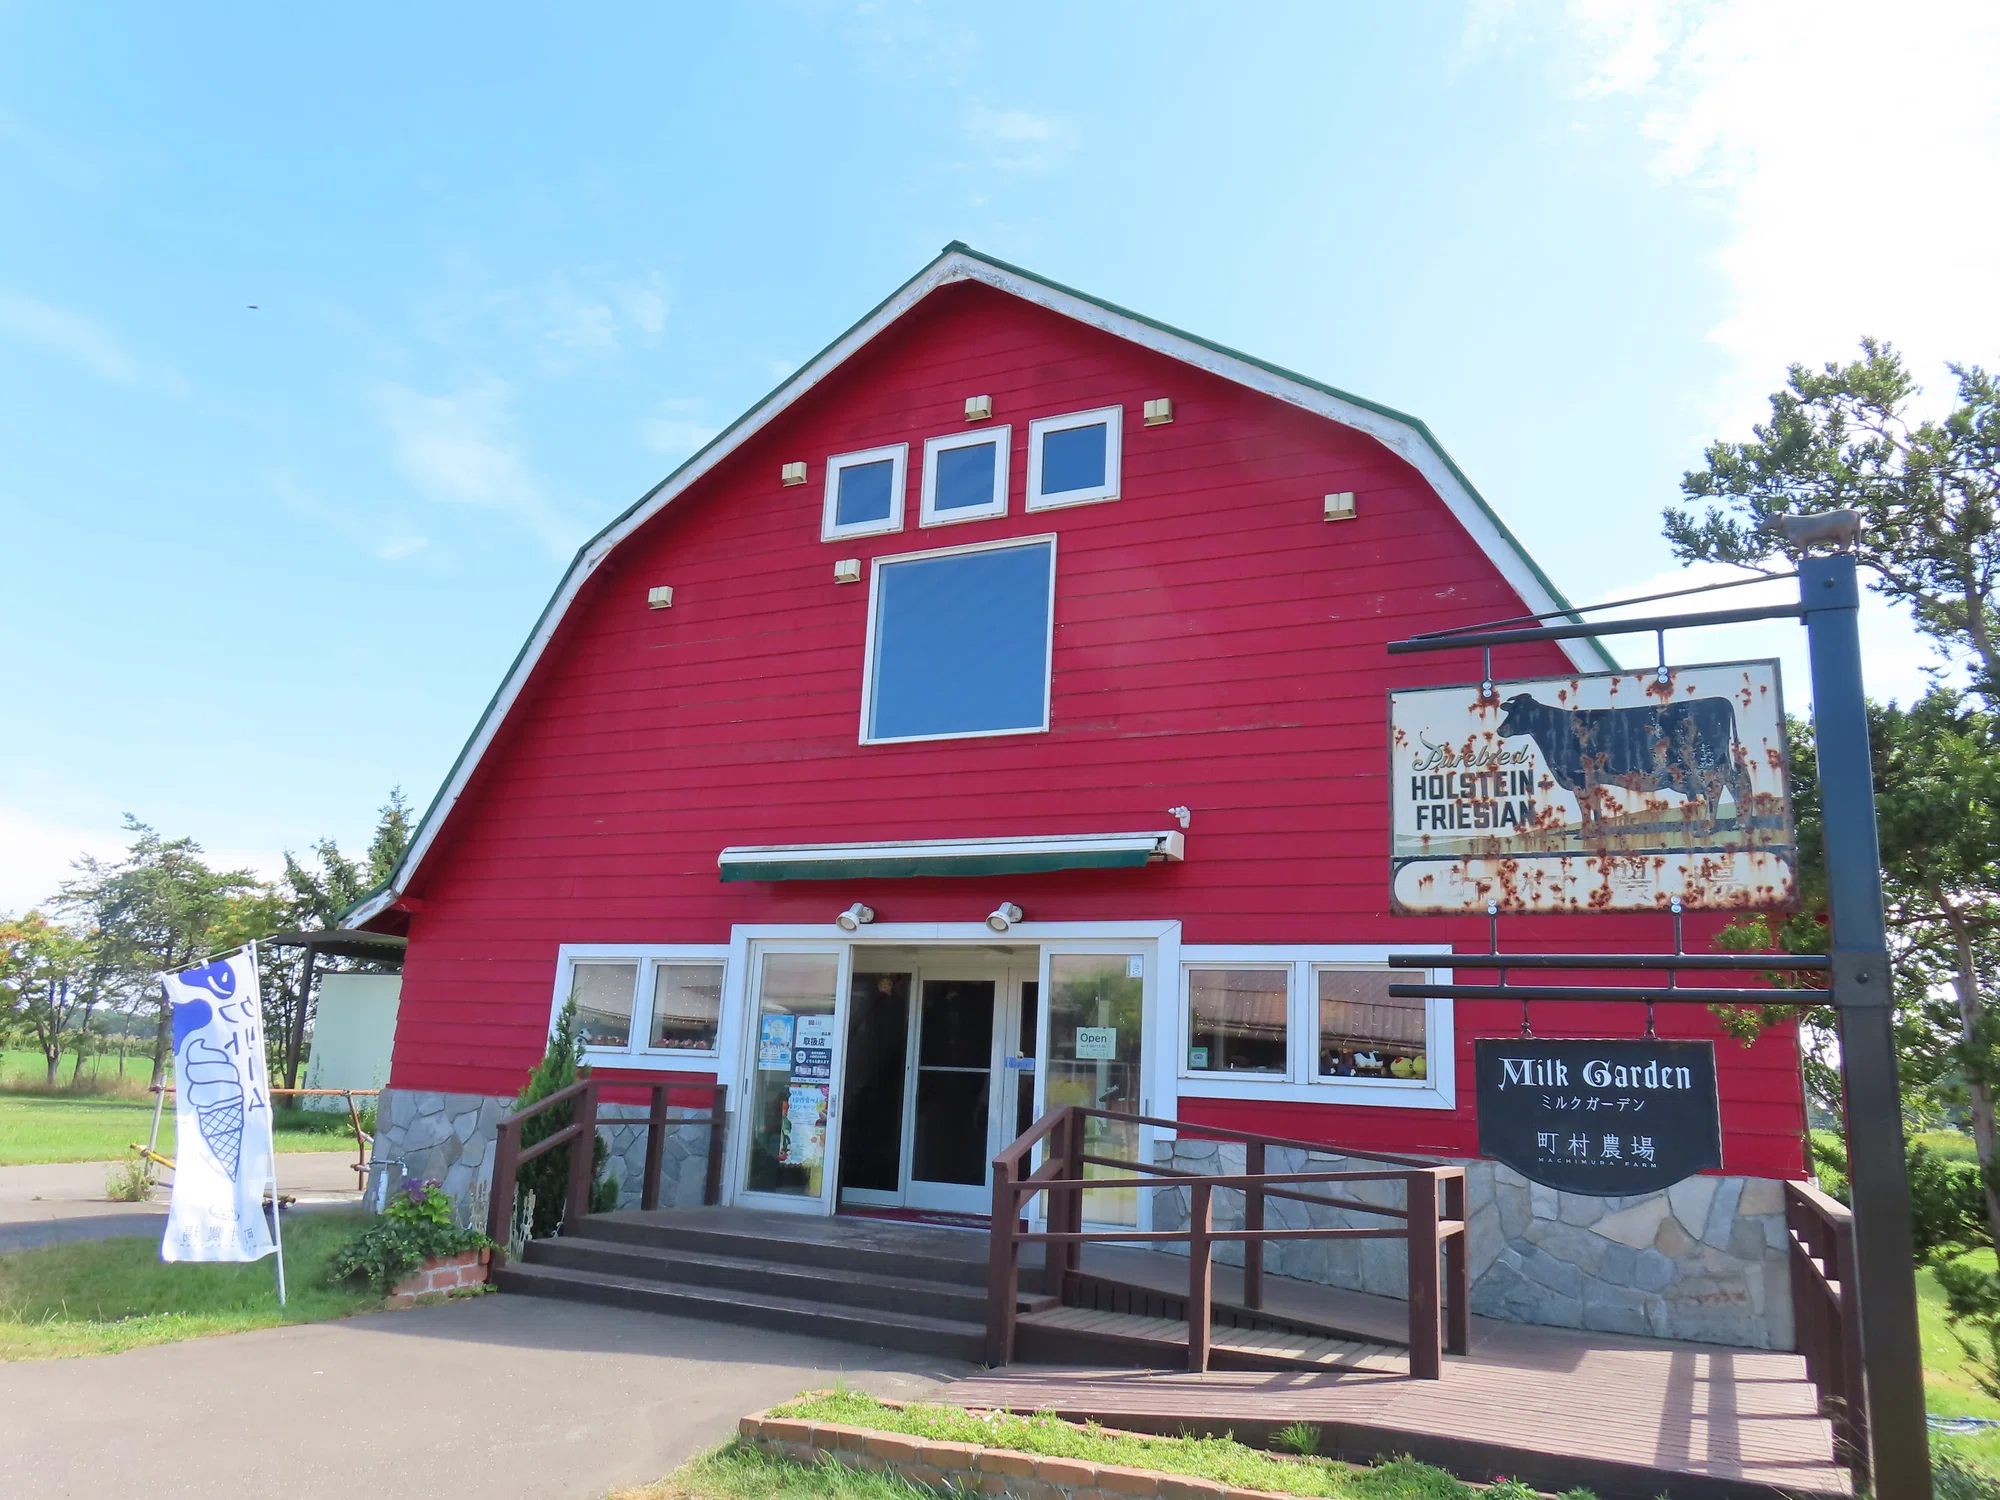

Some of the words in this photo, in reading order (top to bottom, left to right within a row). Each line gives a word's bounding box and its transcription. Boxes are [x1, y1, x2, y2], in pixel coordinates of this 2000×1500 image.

[1411, 768, 1535, 800] HOLSTEIN
[1416, 800, 1536, 830] FRIESIAN
[803, 1037, 825, 1047] 取扱店
[1080, 1033, 1107, 1043] Open
[1498, 1057, 1569, 1090] Milk
[1583, 1059, 1692, 1089] Garden
[1541, 1094, 1645, 1112] ミルクガーデン
[1536, 1131, 1656, 1162] 町村農場
[1538, 1157, 1614, 1166] MACHIMURA
